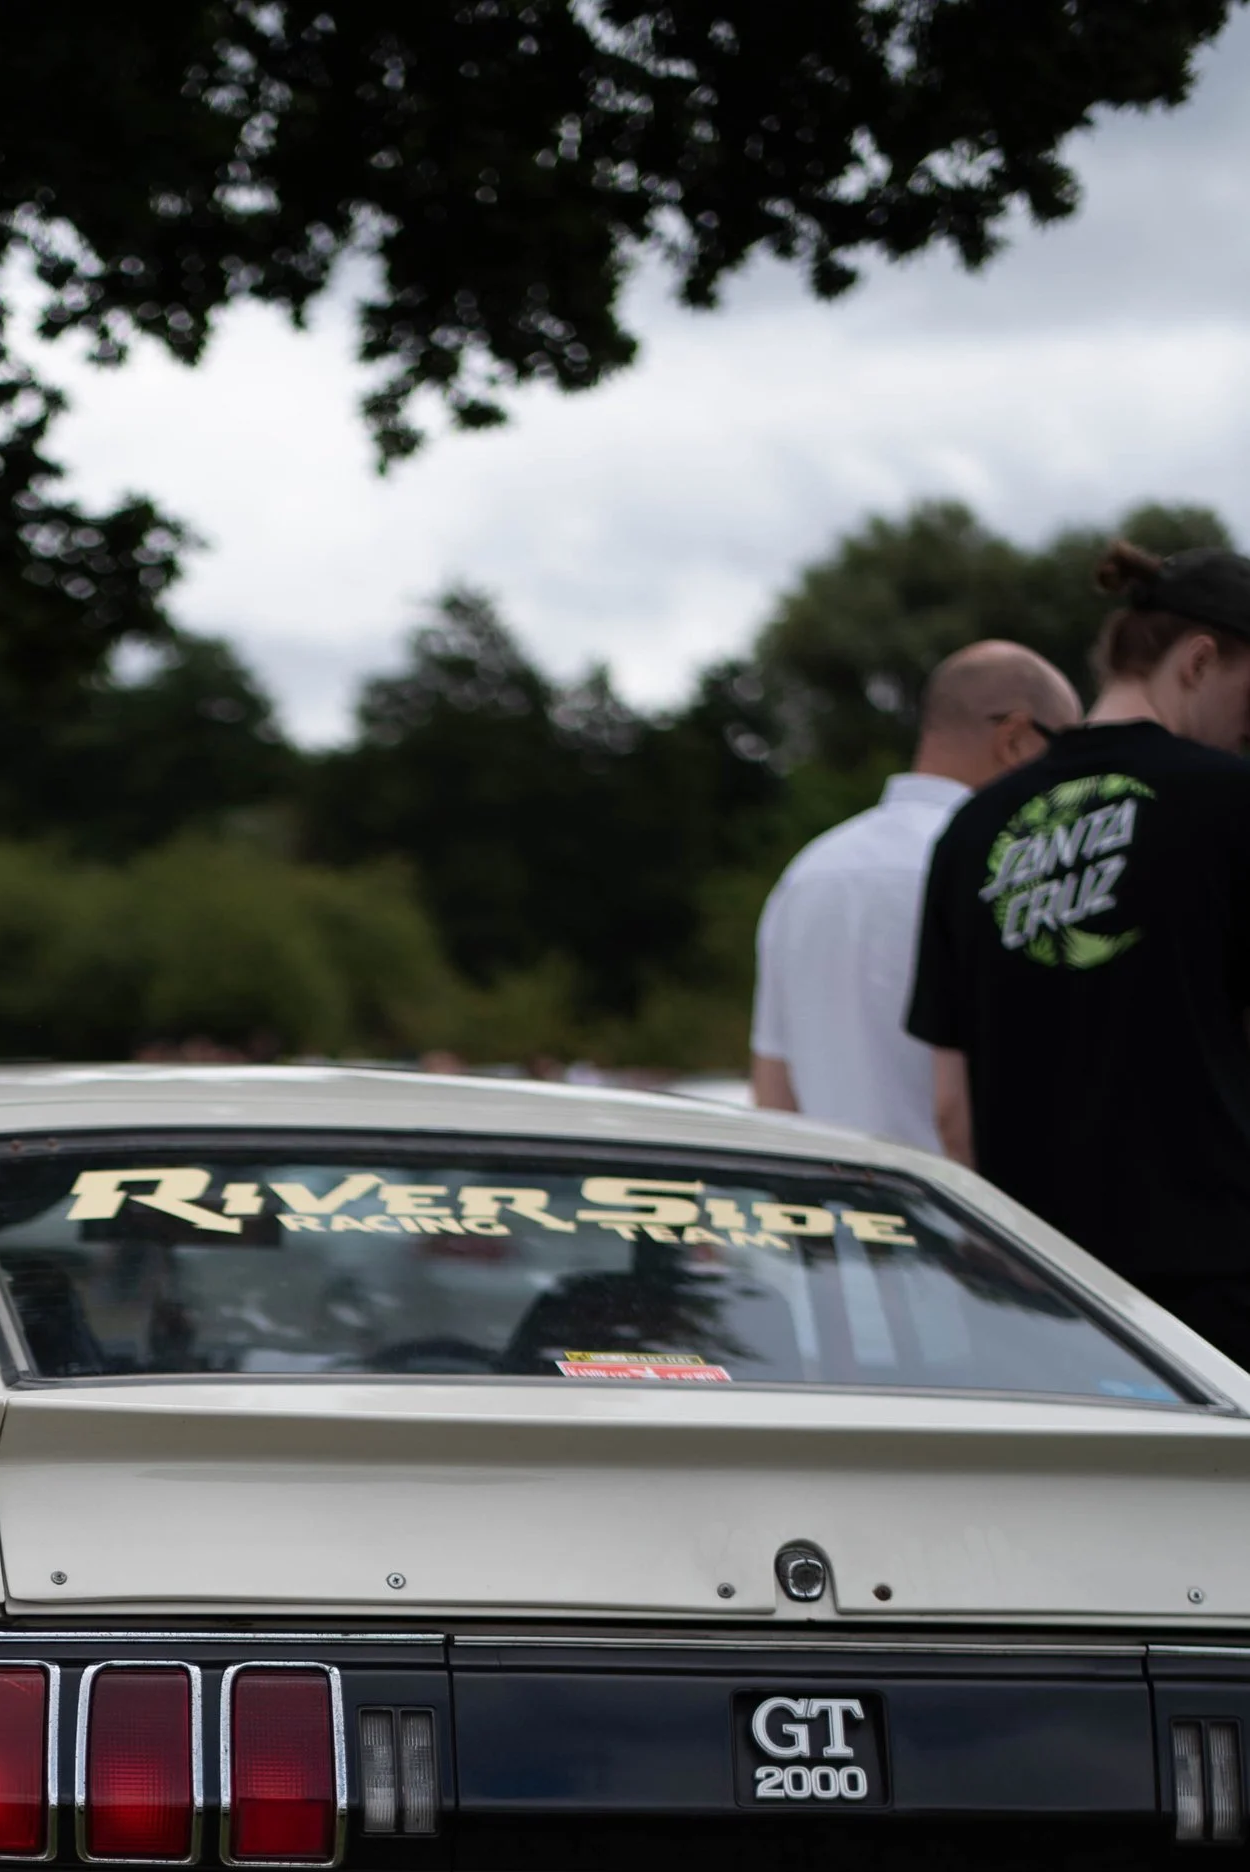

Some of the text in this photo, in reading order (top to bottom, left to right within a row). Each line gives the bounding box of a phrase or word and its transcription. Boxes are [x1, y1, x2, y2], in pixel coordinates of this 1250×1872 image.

[978, 799, 1137, 901] SANTA
[1002, 854, 1127, 950] CRUZ
[66, 1168, 917, 1246] RIVER SIDE
[276, 1213, 791, 1250] RACING TEAM
[752, 1697, 864, 1759] GT
[755, 1766, 868, 1799] 2000
